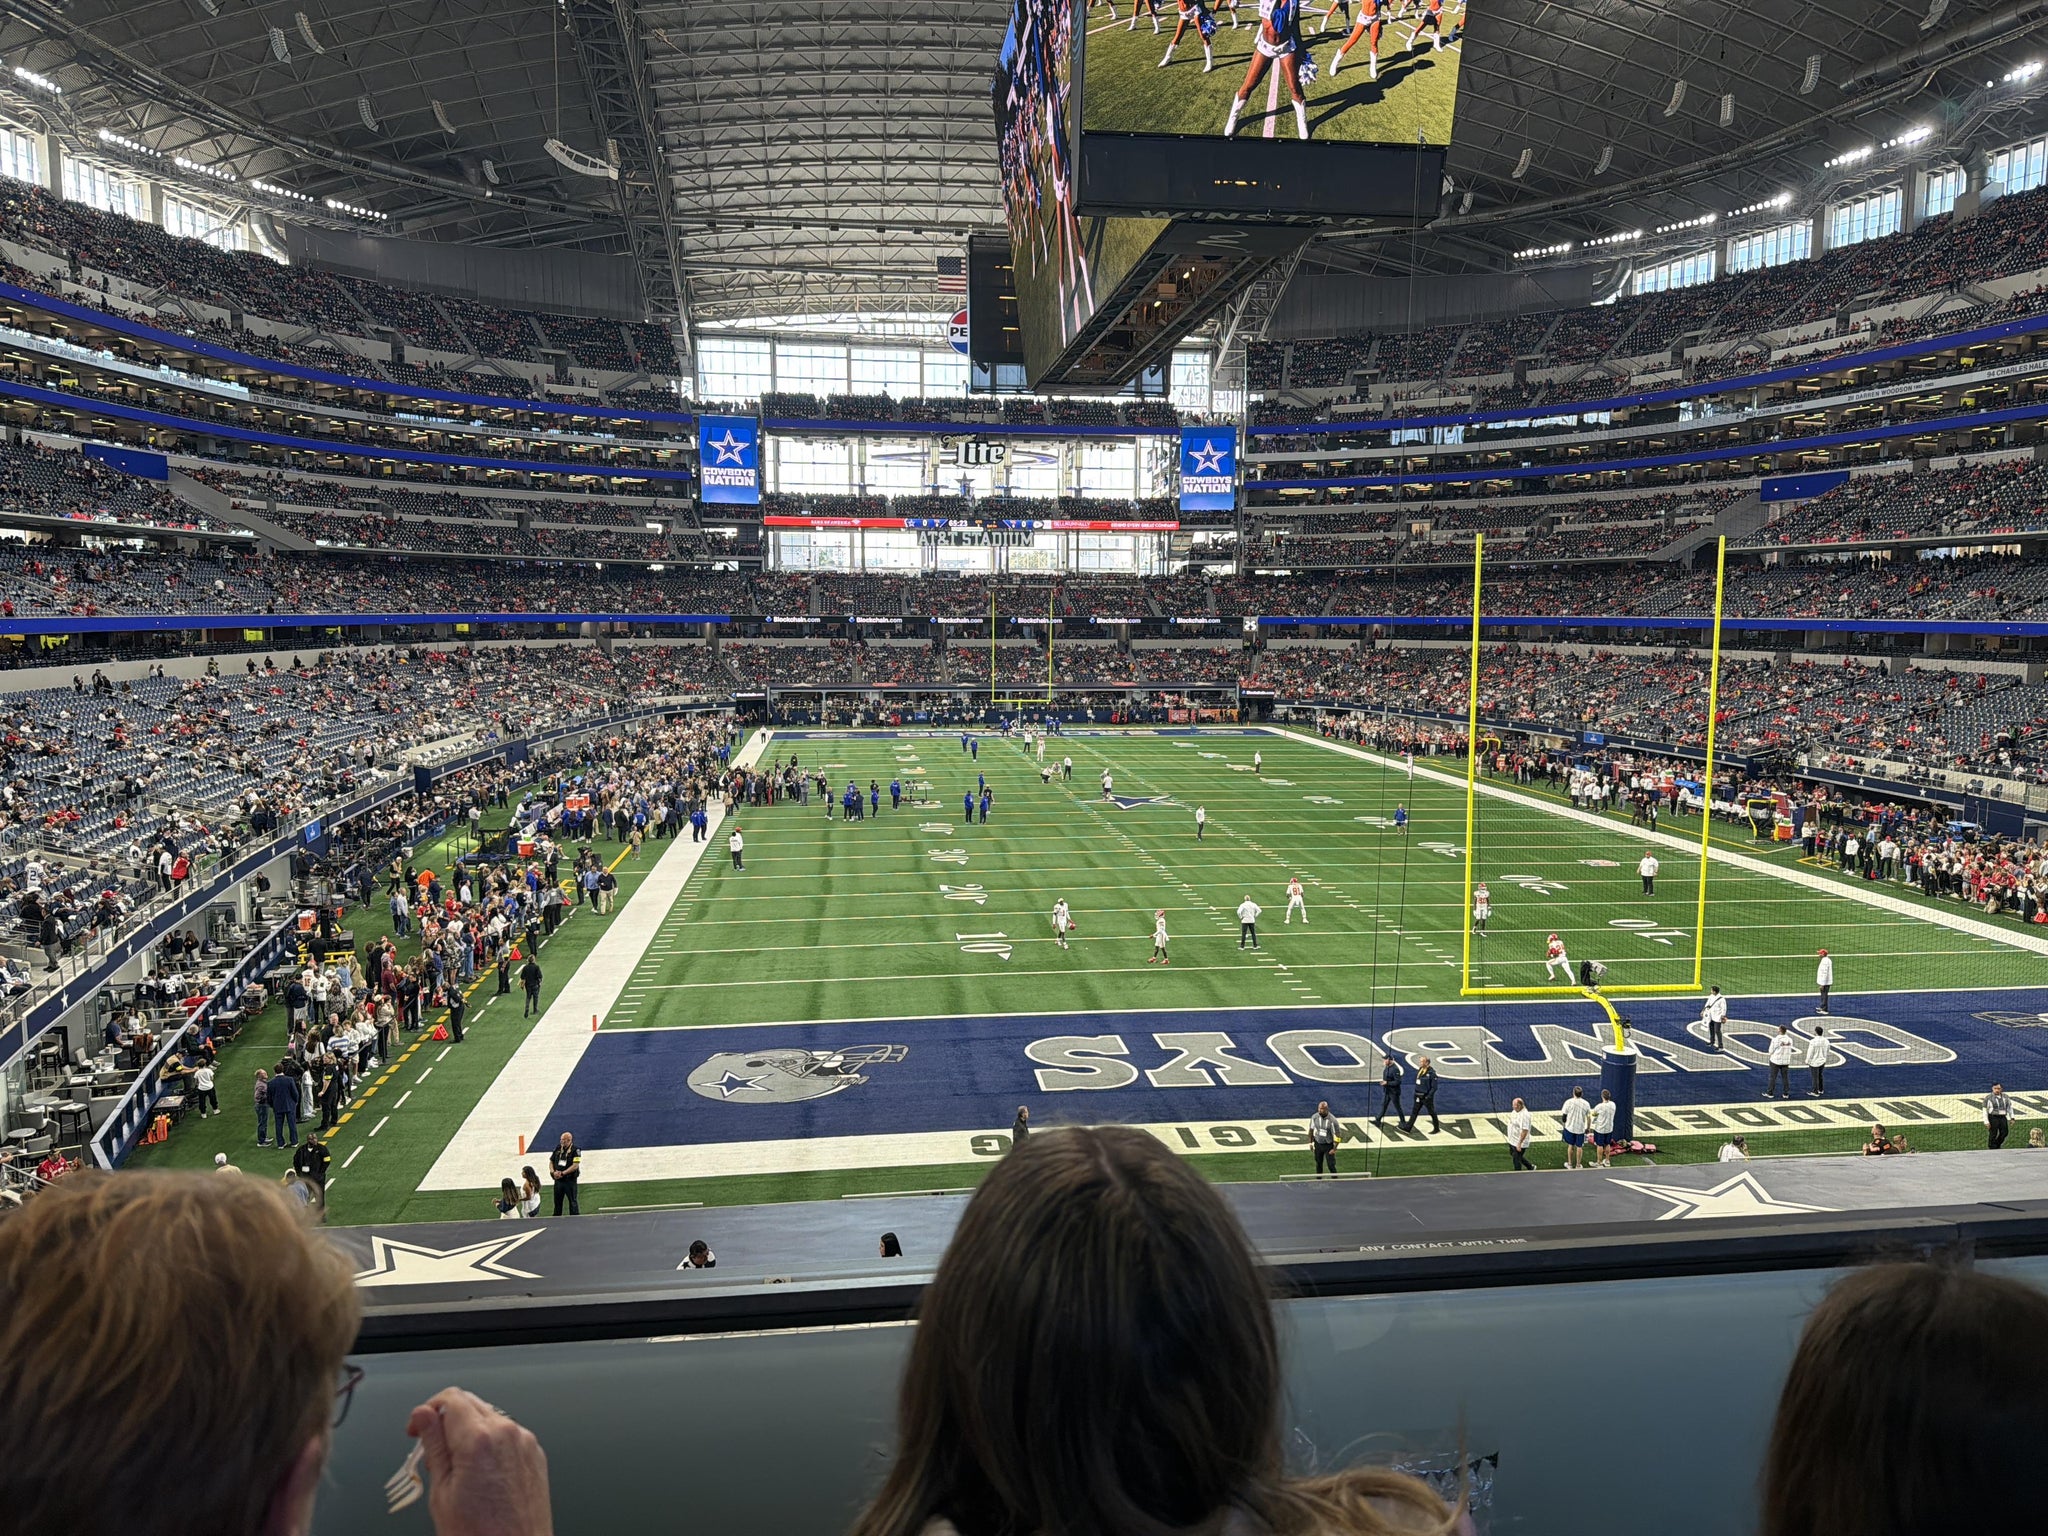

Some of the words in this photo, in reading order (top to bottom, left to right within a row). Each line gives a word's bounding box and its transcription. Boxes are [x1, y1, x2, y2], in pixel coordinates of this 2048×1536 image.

[1140, 210, 1376, 227] WINSTAR
[1996, 363, 2029, 376] CHARLES
[2029, 360, 2048, 370] HALE
[1881, 385, 1913, 396] WOODSON
[955, 440, 1005, 469] Lite
[703, 467, 756, 477] COWBOYS
[1182, 475, 1232, 484] COWBOYS
[704, 475, 755, 486] NATION
[1183, 483, 1231, 493] NATION
[919, 530, 959, 546] AT&T
[961, 531, 1034, 547] STADIUM
[938, 883, 989, 900] 20
[955, 931, 1014, 953] 10
[1024, 1015, 1958, 1091] COWBOYS
[1630, 1101, 1952, 1131] MADDEN
[1391, 1241, 1453, 1251] CONTACT
[1458, 1239, 1494, 1247] WITH
